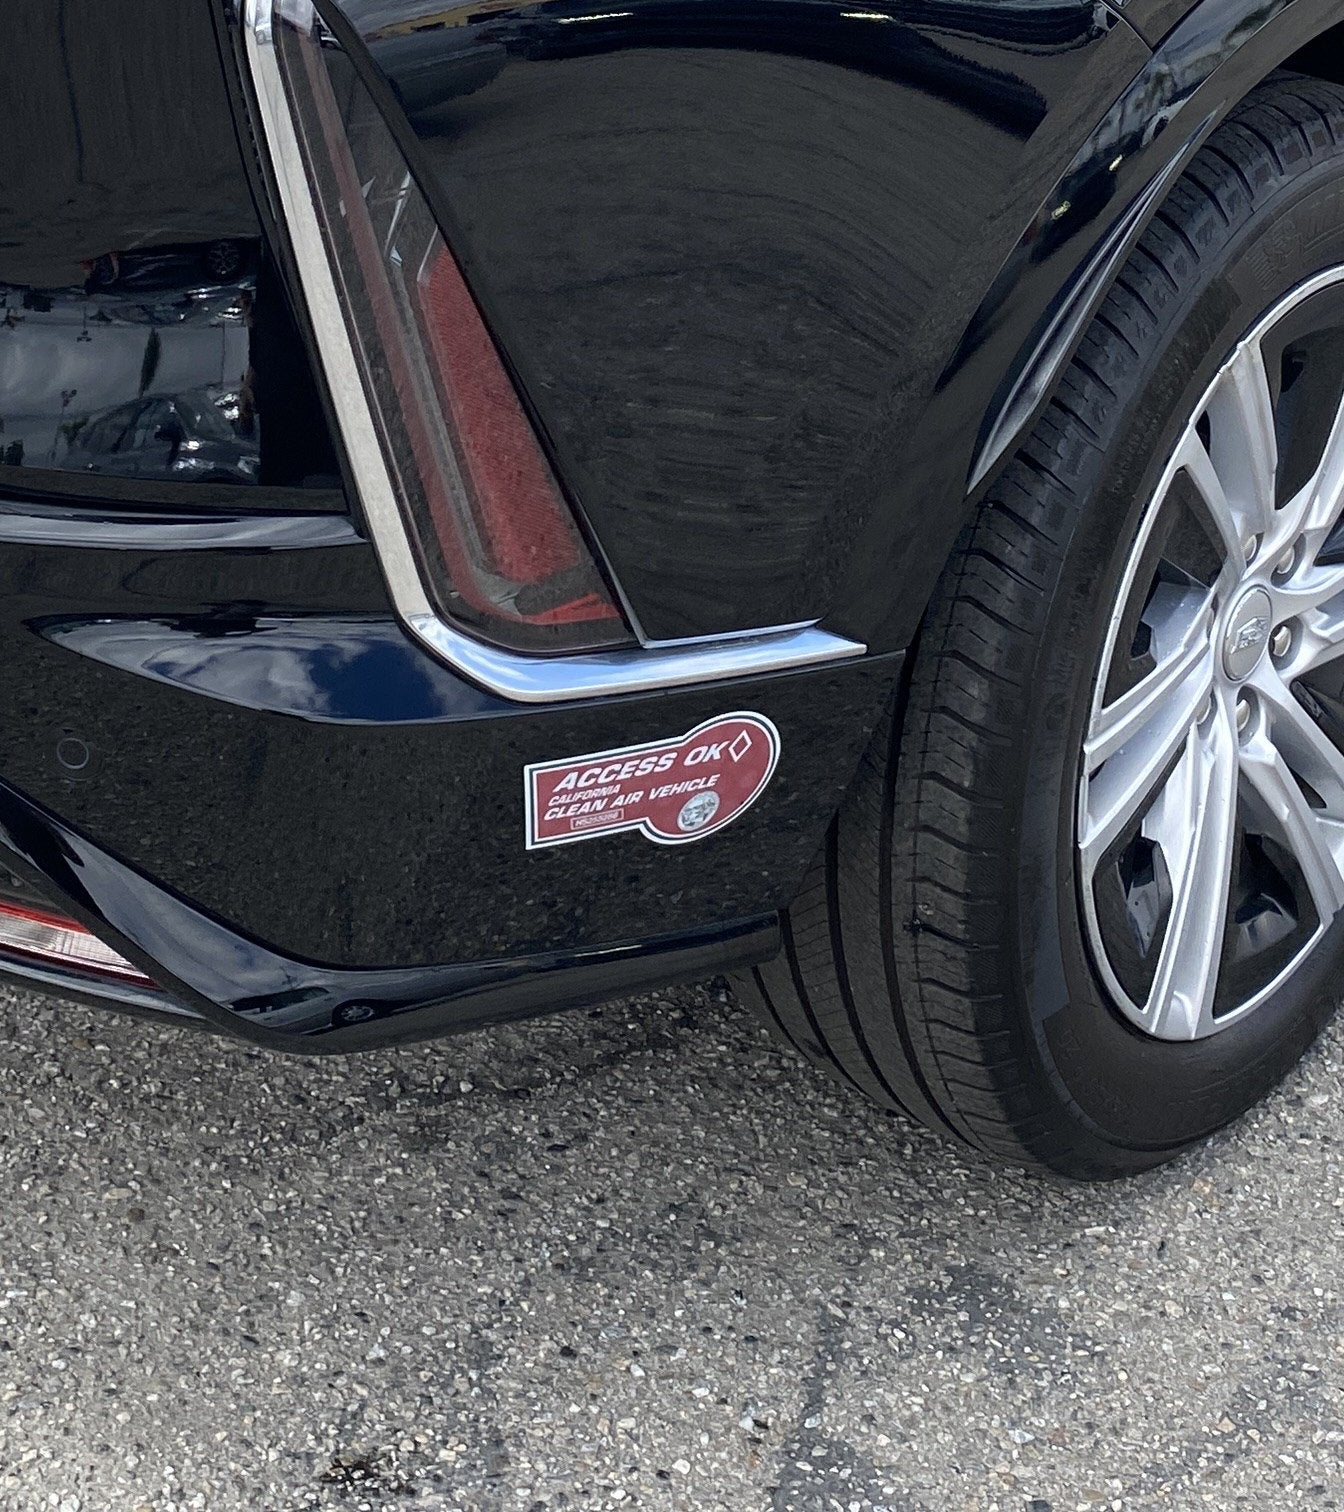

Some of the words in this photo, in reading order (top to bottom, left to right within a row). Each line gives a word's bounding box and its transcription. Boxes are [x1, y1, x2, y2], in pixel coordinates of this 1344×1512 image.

[552, 751, 678, 793] ACCESS
[683, 740, 730, 767] OK
[544, 798, 609, 821] CLEAN
[610, 790, 644, 809] AIR
[648, 773, 721, 801] VEHICLE
[548, 784, 621, 806] CALIFORNIA
